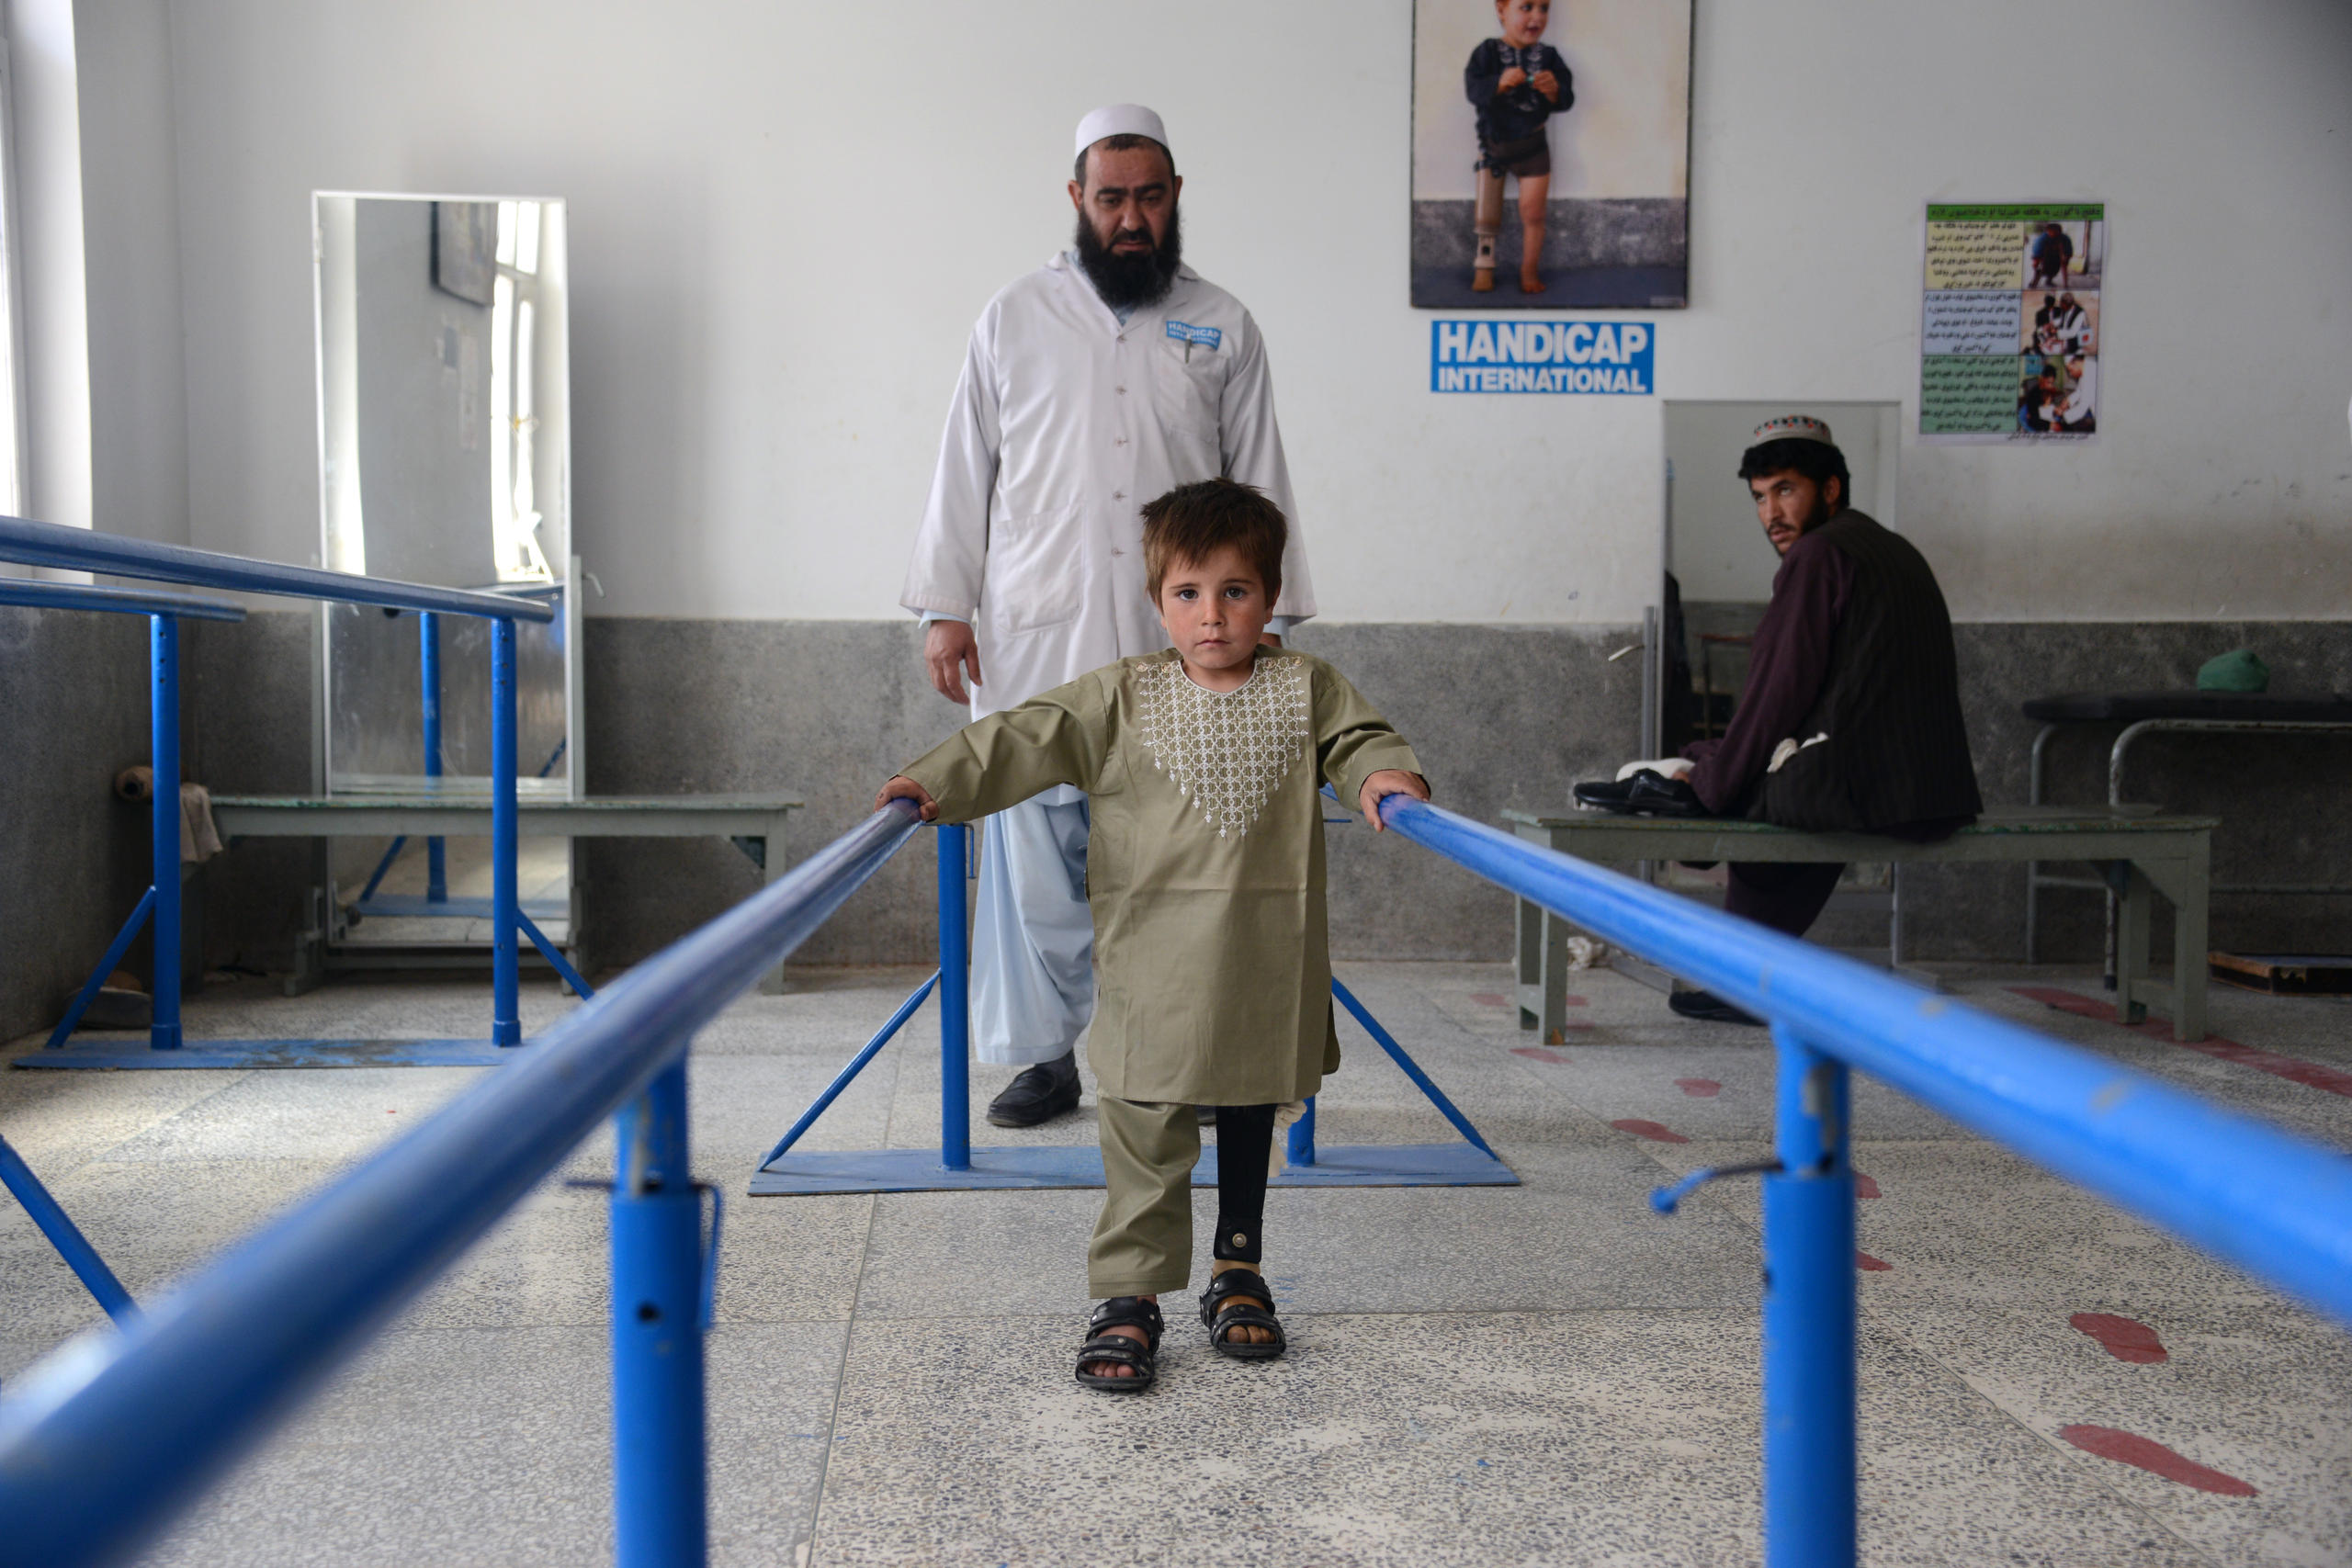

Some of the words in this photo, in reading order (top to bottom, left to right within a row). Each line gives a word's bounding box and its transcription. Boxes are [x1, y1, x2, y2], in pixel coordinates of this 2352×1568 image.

[1168, 322, 1219, 339] HANDICAP
[1438, 322, 1648, 364] HANDICAP
[1438, 367, 1647, 392] INTERNATIONAL
